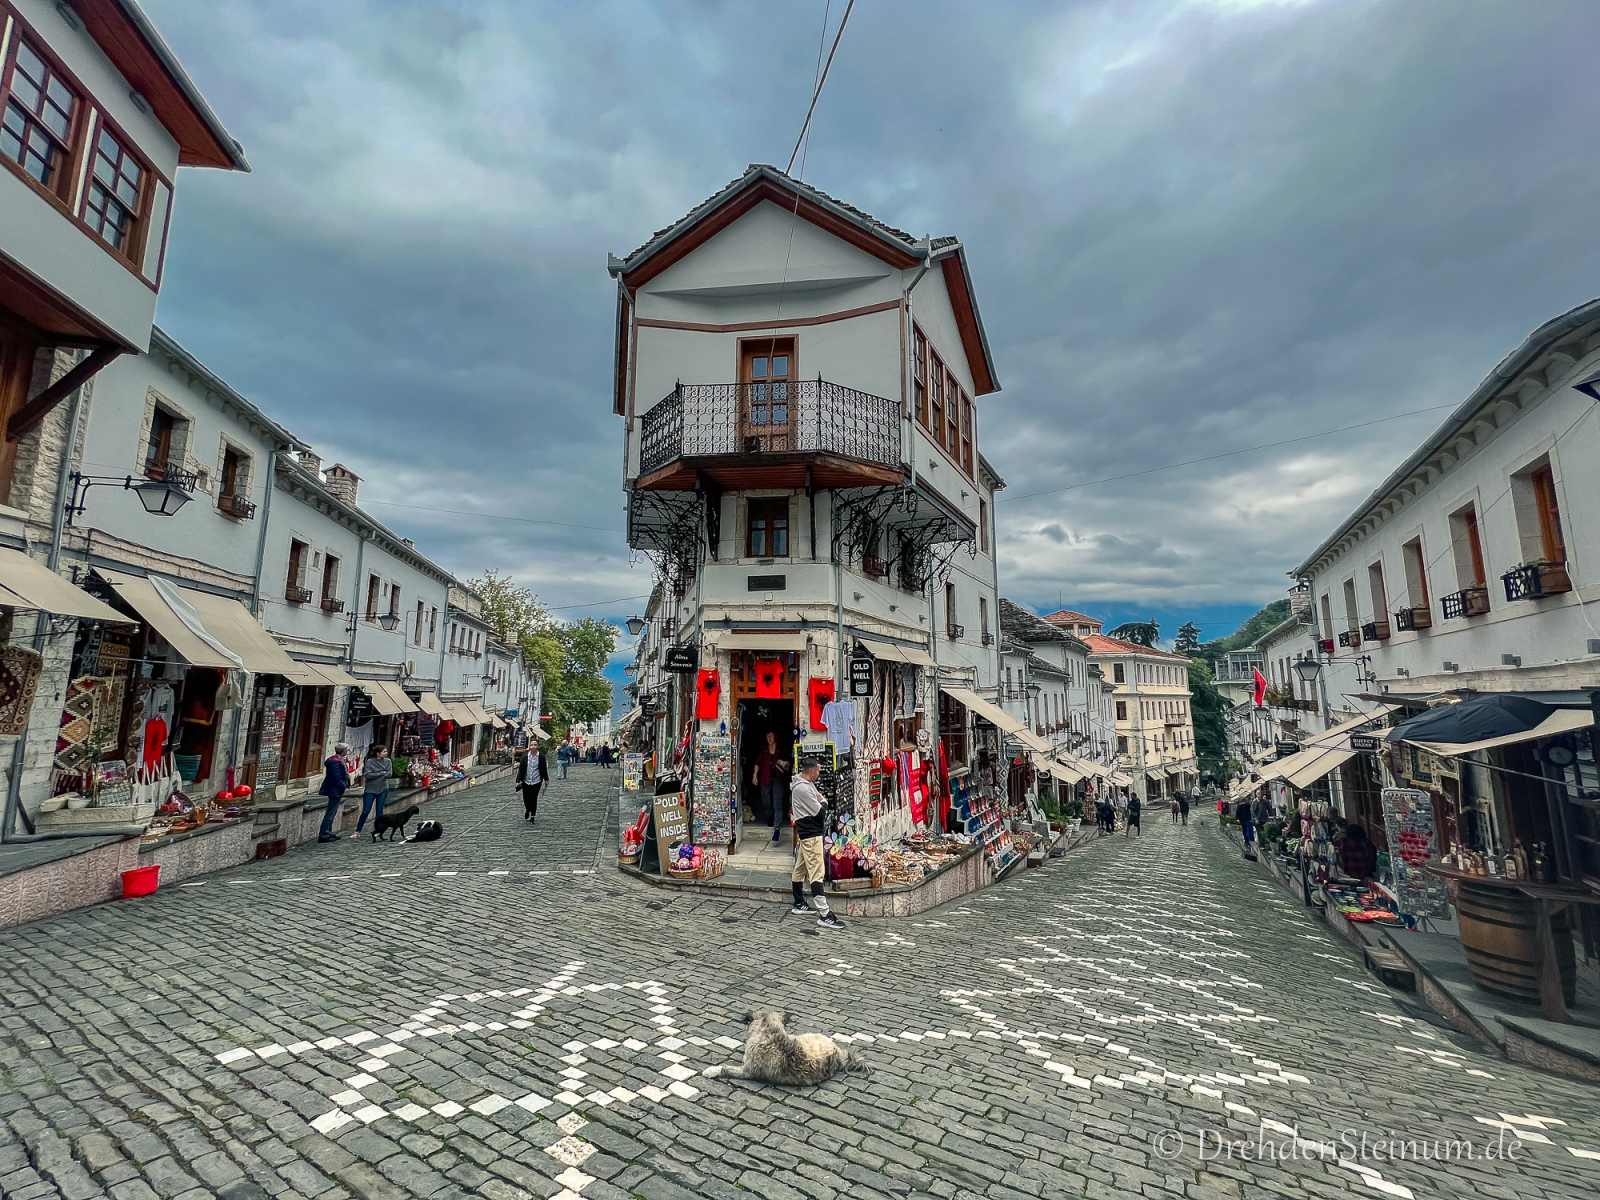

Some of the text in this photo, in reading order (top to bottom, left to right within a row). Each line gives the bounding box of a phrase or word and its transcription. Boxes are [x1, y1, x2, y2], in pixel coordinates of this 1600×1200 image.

[852, 672, 870, 680] WELL
[662, 796, 678, 808] OLD
[660, 809, 683, 823] WELL
[659, 823, 687, 838] INSIDE
